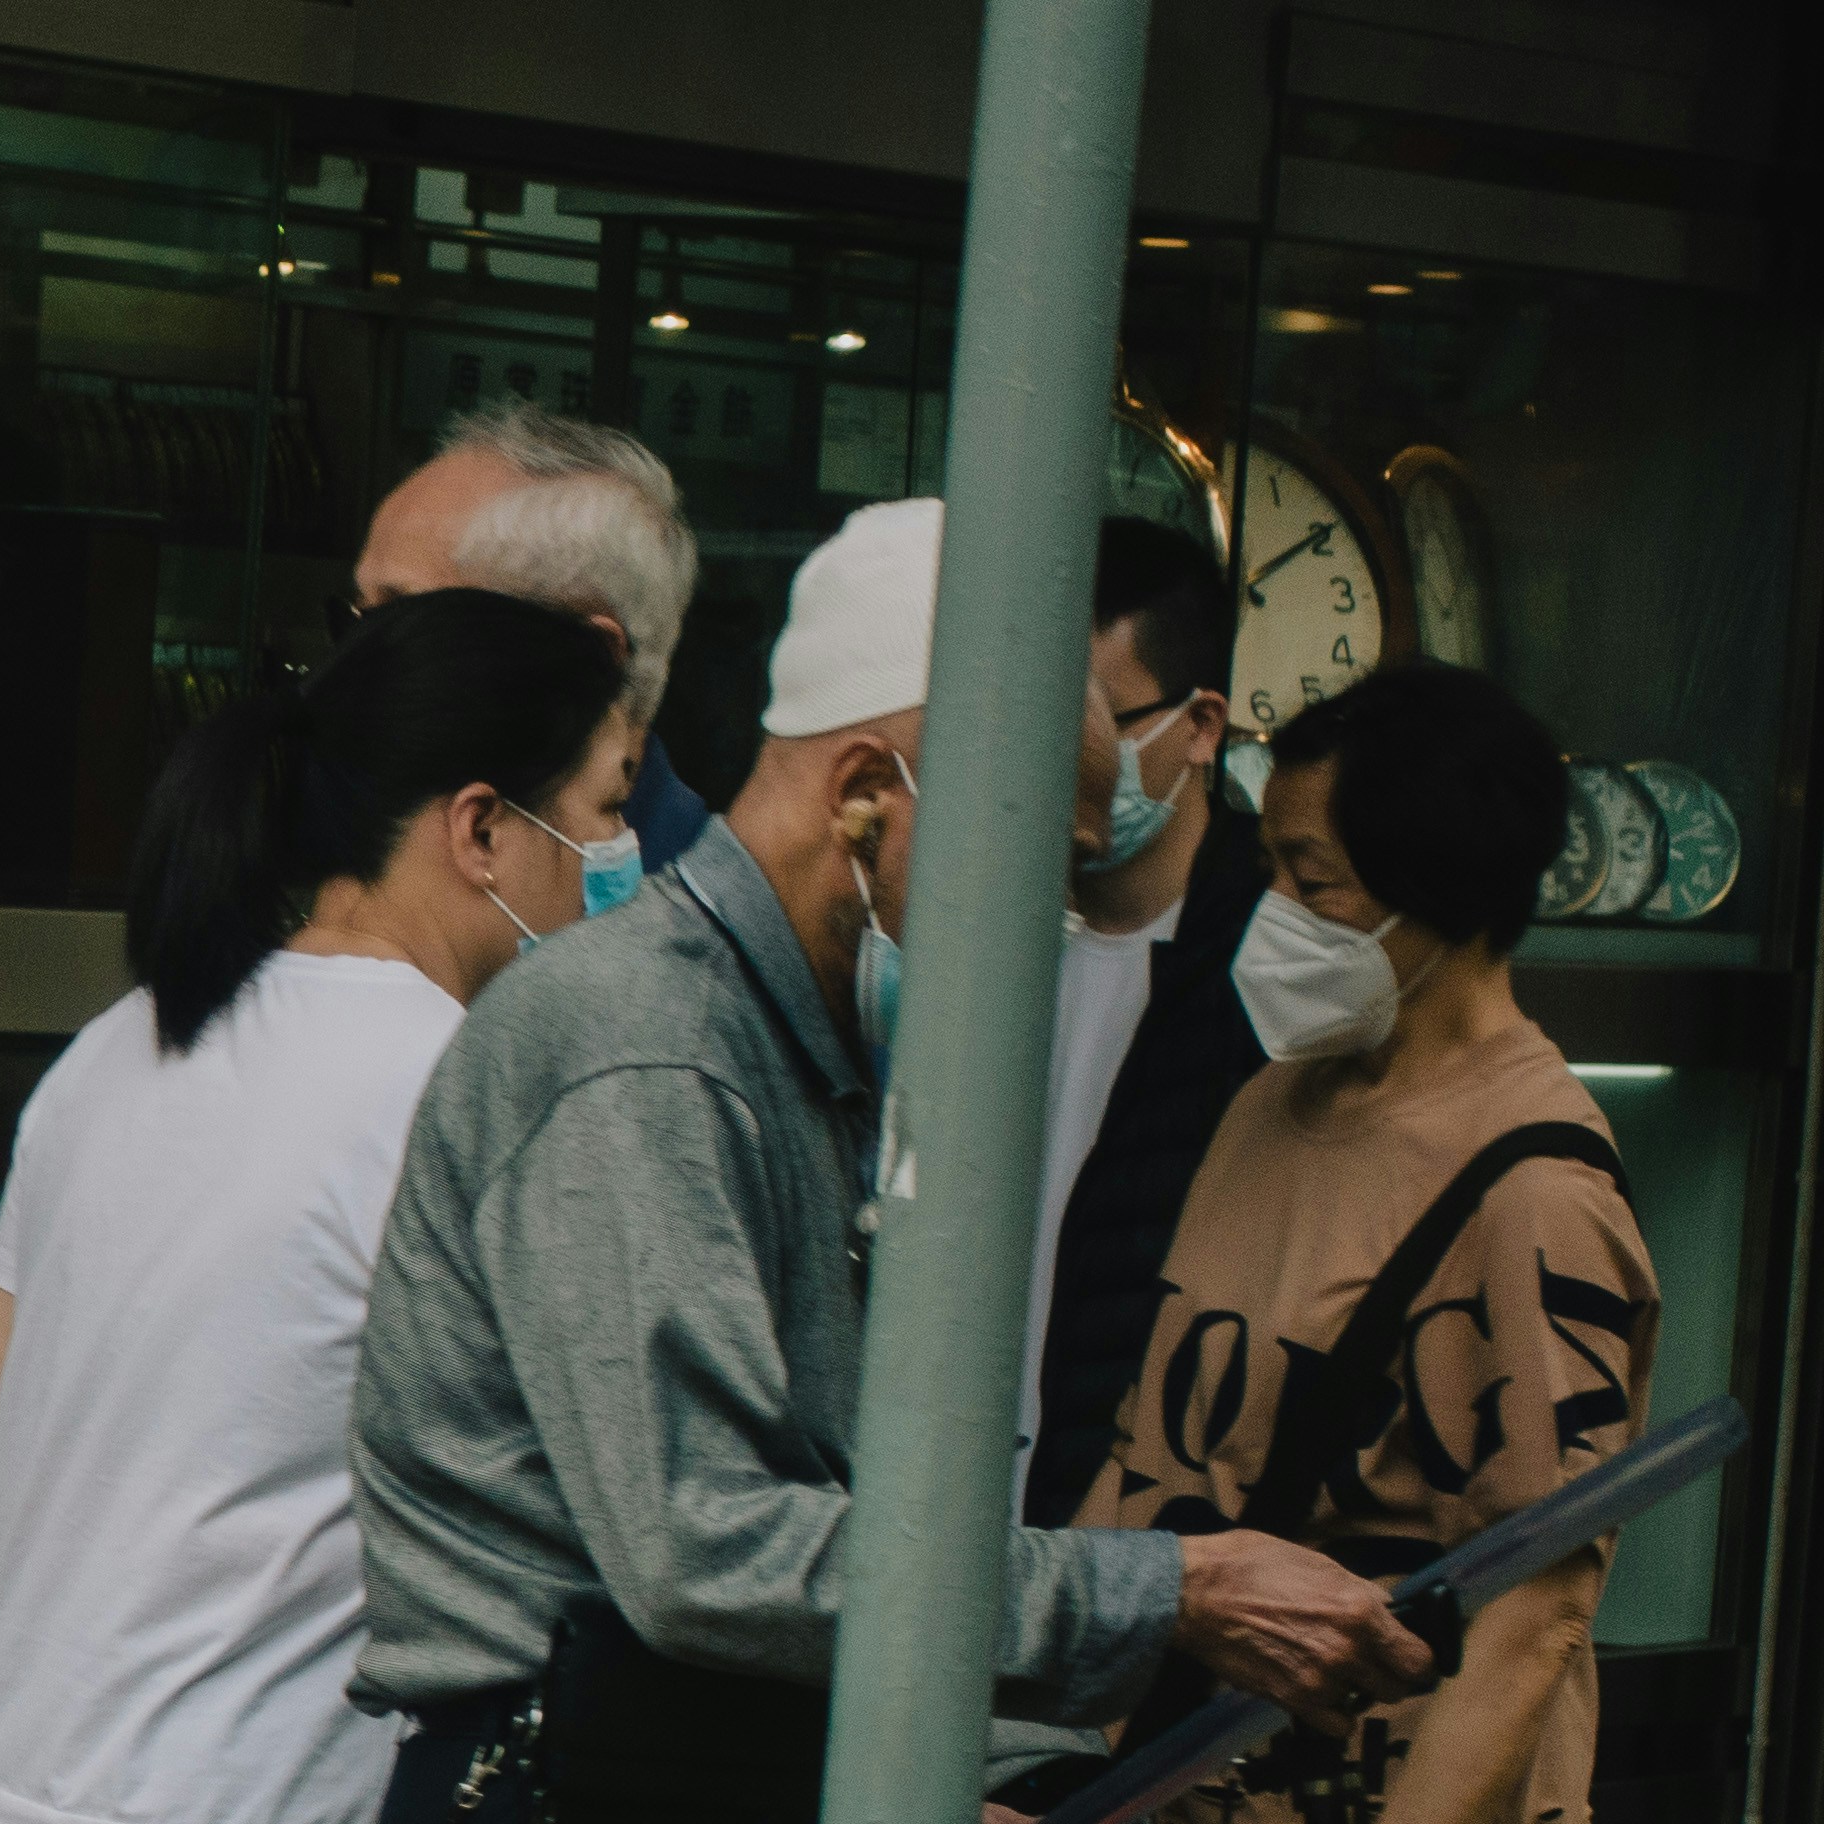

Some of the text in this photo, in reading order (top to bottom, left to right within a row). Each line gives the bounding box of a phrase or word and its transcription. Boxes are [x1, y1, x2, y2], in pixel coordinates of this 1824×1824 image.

[1329, 577, 1356, 614] 3
[1332, 634, 1355, 667] 4
[1249, 690, 1276, 724] 6
